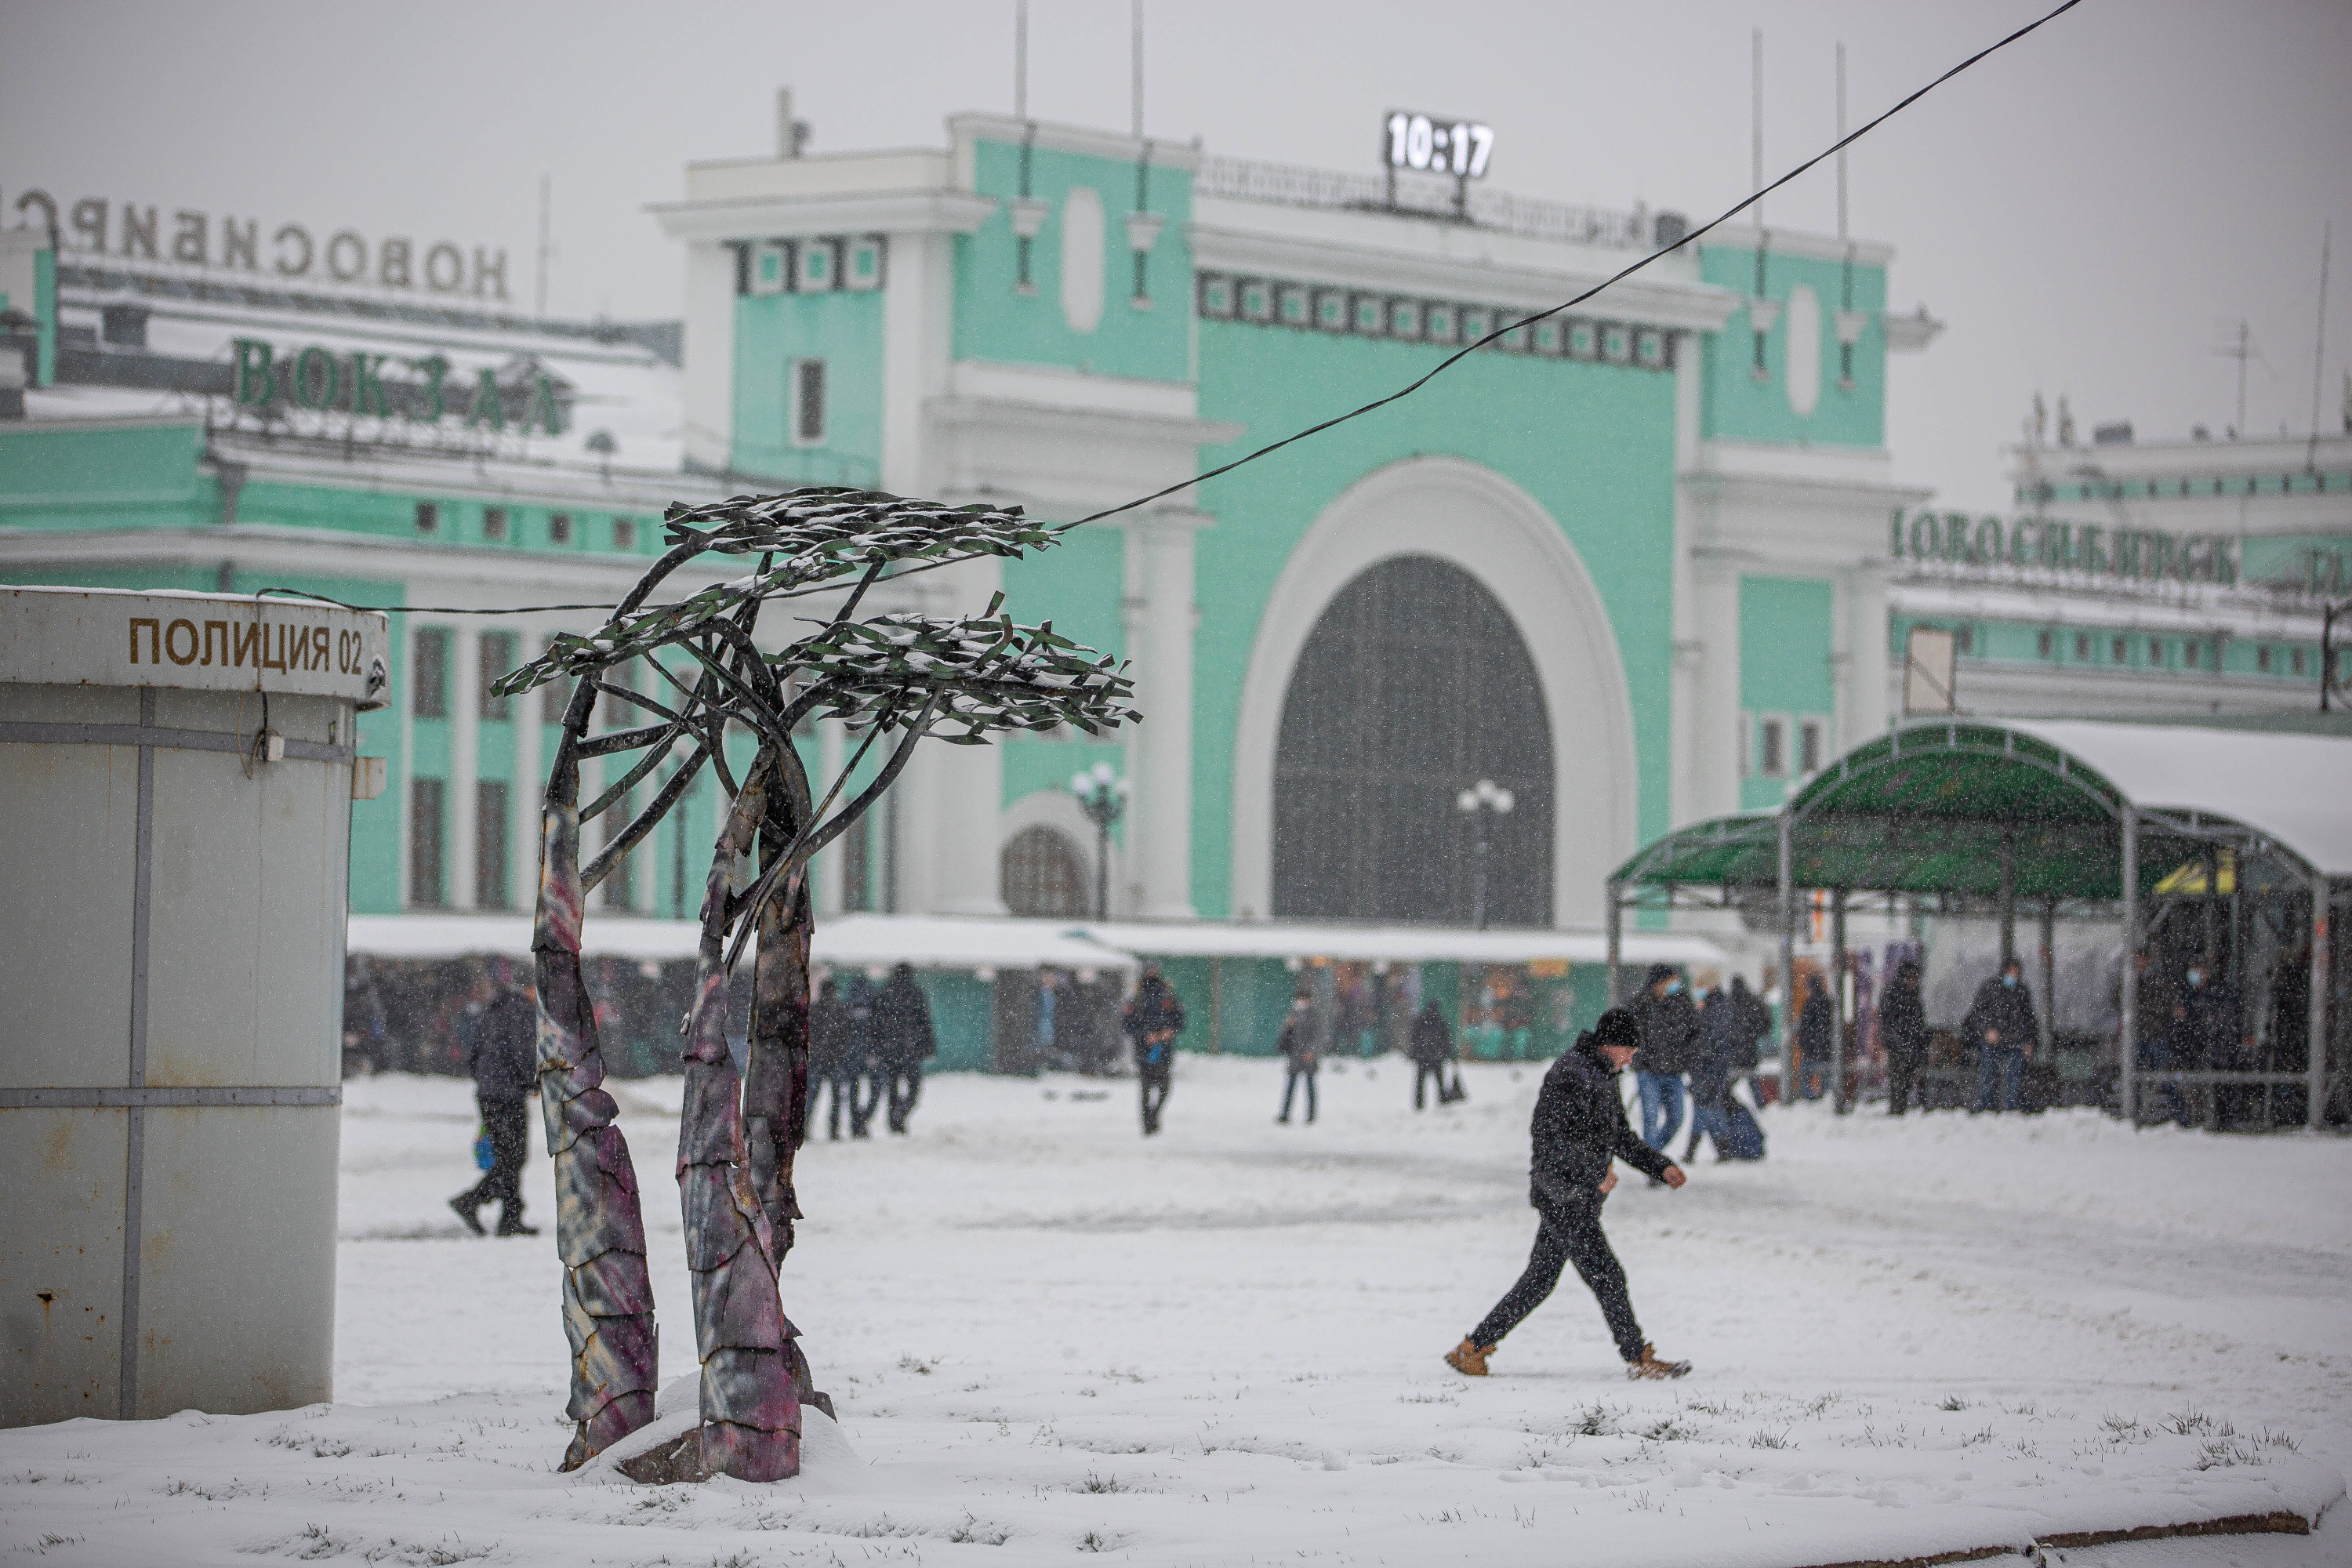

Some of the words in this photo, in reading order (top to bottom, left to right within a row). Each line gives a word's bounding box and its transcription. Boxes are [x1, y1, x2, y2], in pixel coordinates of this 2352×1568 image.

[1388, 113, 1494, 177] 10:17
[231, 337, 562, 437] ВОКЗАЛ
[129, 617, 331, 676] ПОЛИЦИЯ
[339, 628, 363, 676] 02
